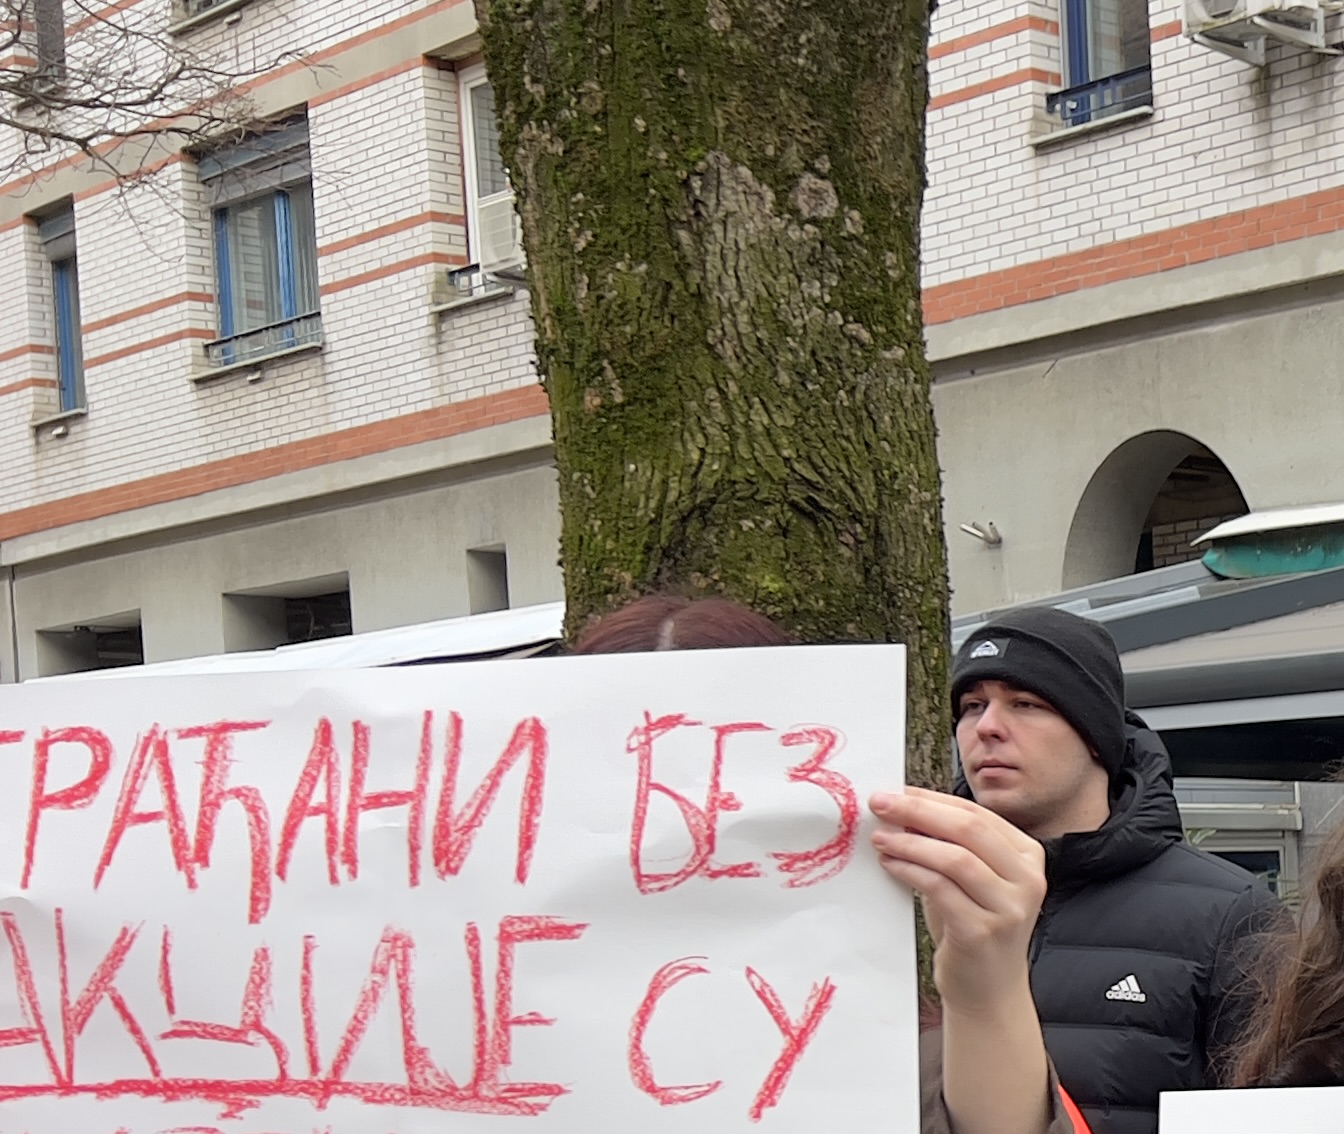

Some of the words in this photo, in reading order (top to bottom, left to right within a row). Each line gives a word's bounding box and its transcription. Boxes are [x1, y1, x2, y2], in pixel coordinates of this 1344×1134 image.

[0, 710, 549, 925] РАЂАНИ
[626, 710, 860, 894] БЕЗ
[630, 956, 838, 1121] СУ
